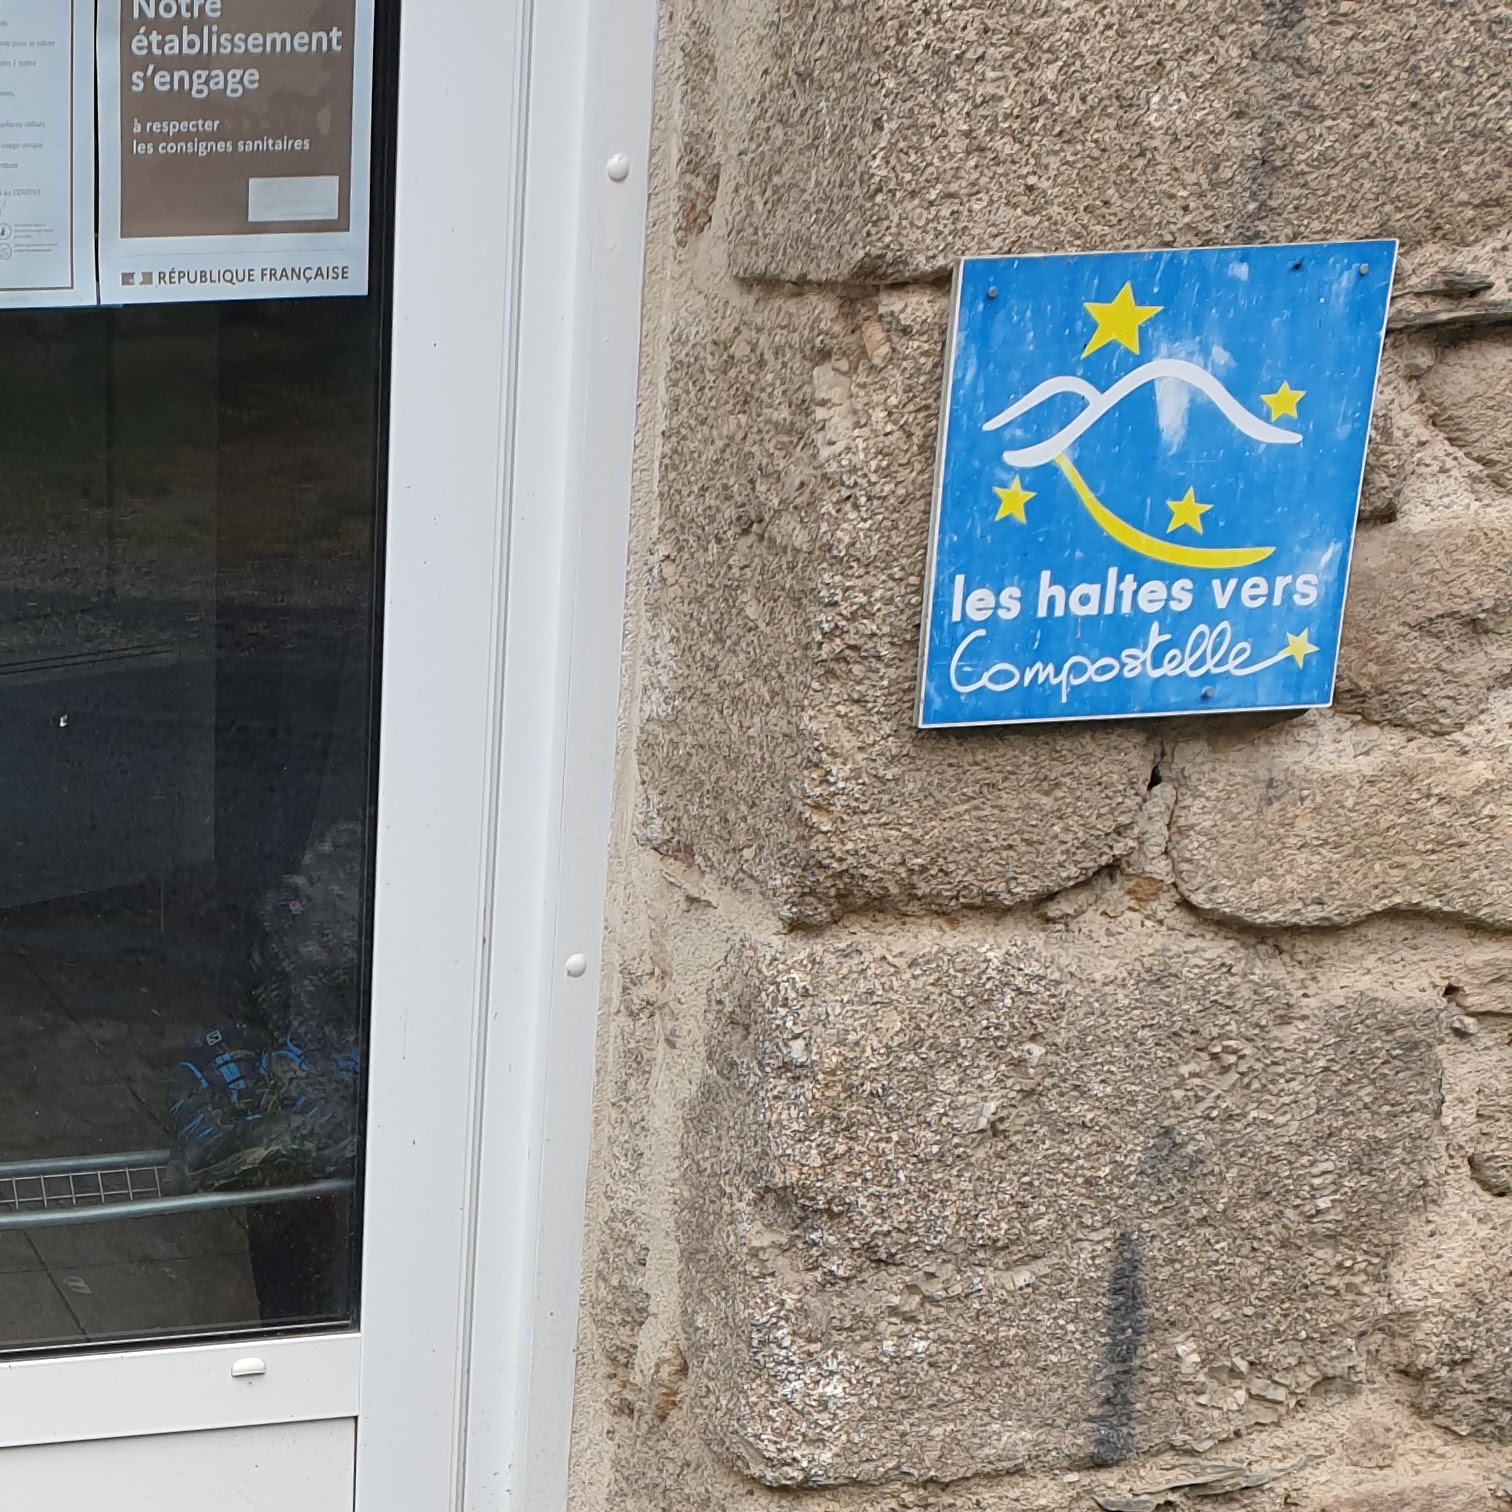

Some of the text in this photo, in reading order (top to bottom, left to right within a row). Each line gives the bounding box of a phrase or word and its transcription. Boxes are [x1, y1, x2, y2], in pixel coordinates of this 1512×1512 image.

[132, 0, 222, 19] Notre
[130, 24, 343, 56] établissement
[131, 63, 261, 99] s'engage
[132, 117, 220, 137] à respecter
[133, 135, 311, 157] les consignes sanitaires
[157, 265, 350, 286] RÉPUBLIQUE FRANÇAISE
[950, 569, 1320, 623] les haltes vers
[949, 619, 1292, 705] Compostelle
